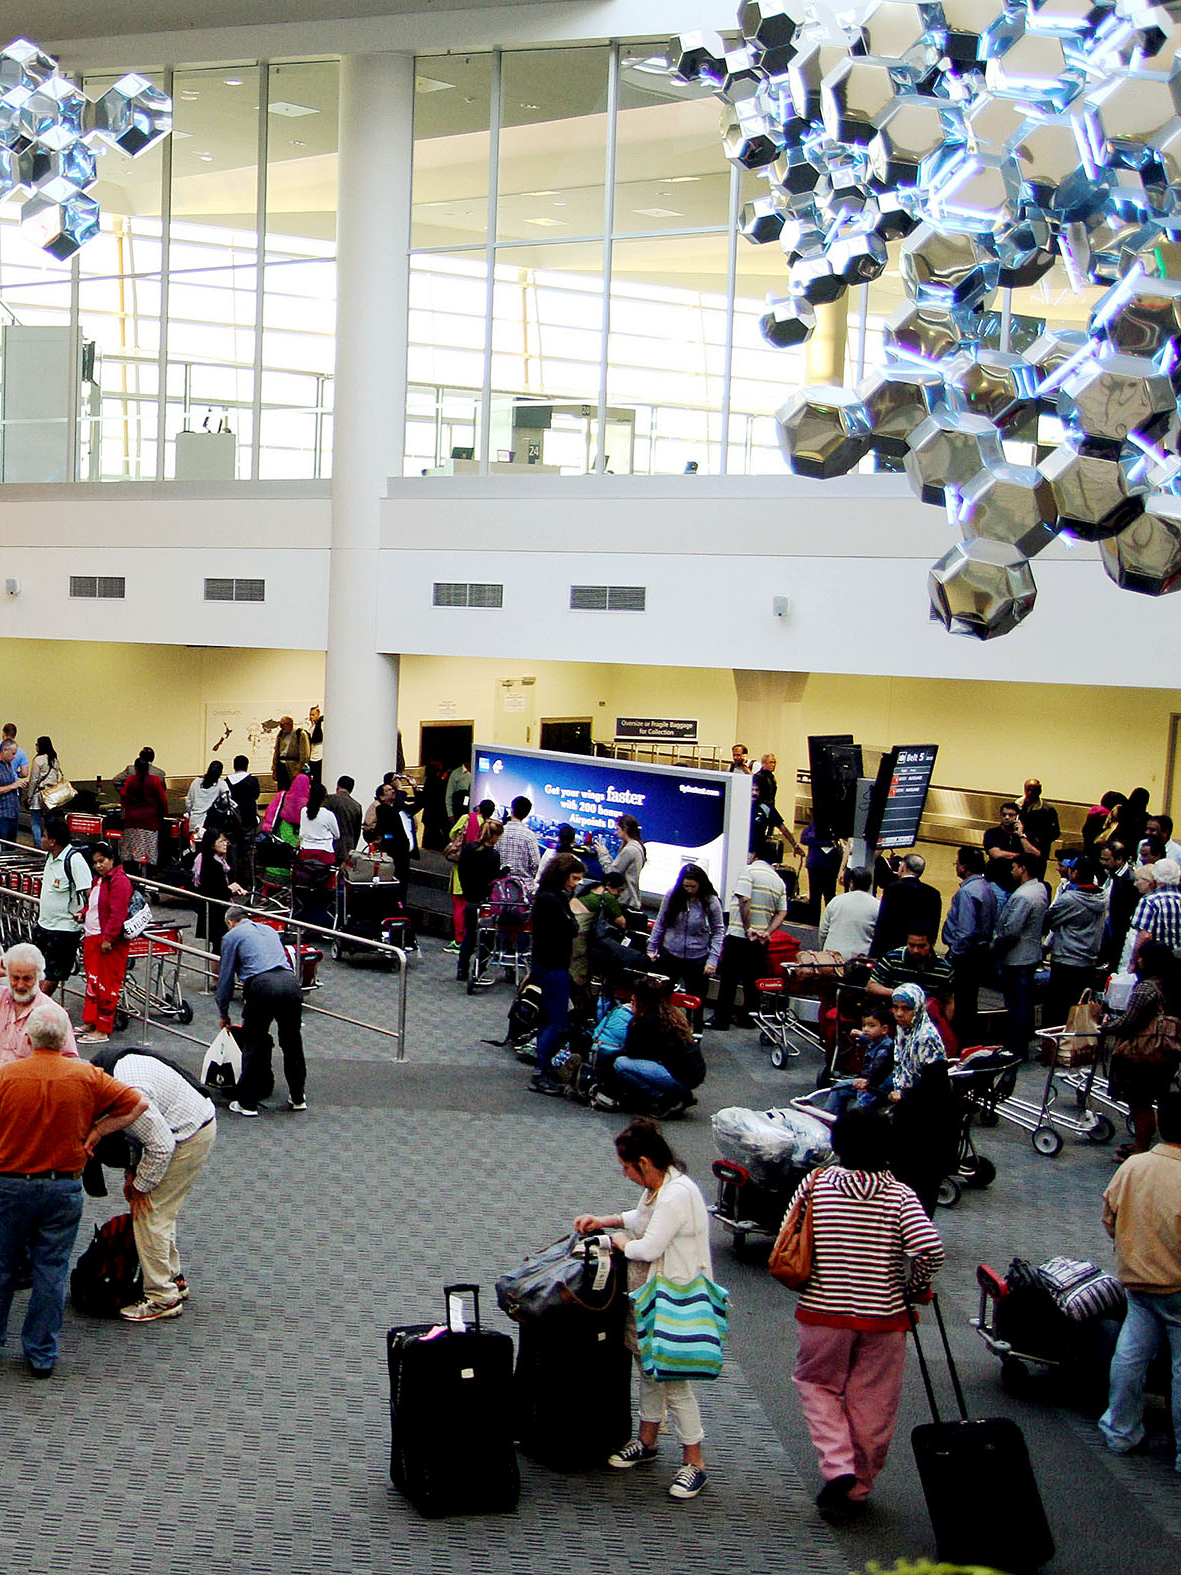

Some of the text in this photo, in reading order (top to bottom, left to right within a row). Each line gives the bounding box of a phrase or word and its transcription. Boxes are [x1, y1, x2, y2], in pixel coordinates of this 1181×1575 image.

[529, 445, 539, 456] 24
[906, 753, 918, 762] Belt
[919, 752, 925, 762] 5
[544, 784, 646, 805] Get your wings faster
[561, 799, 623, 818] with 200 bonus
[569, 812, 607, 828] Airpoints
